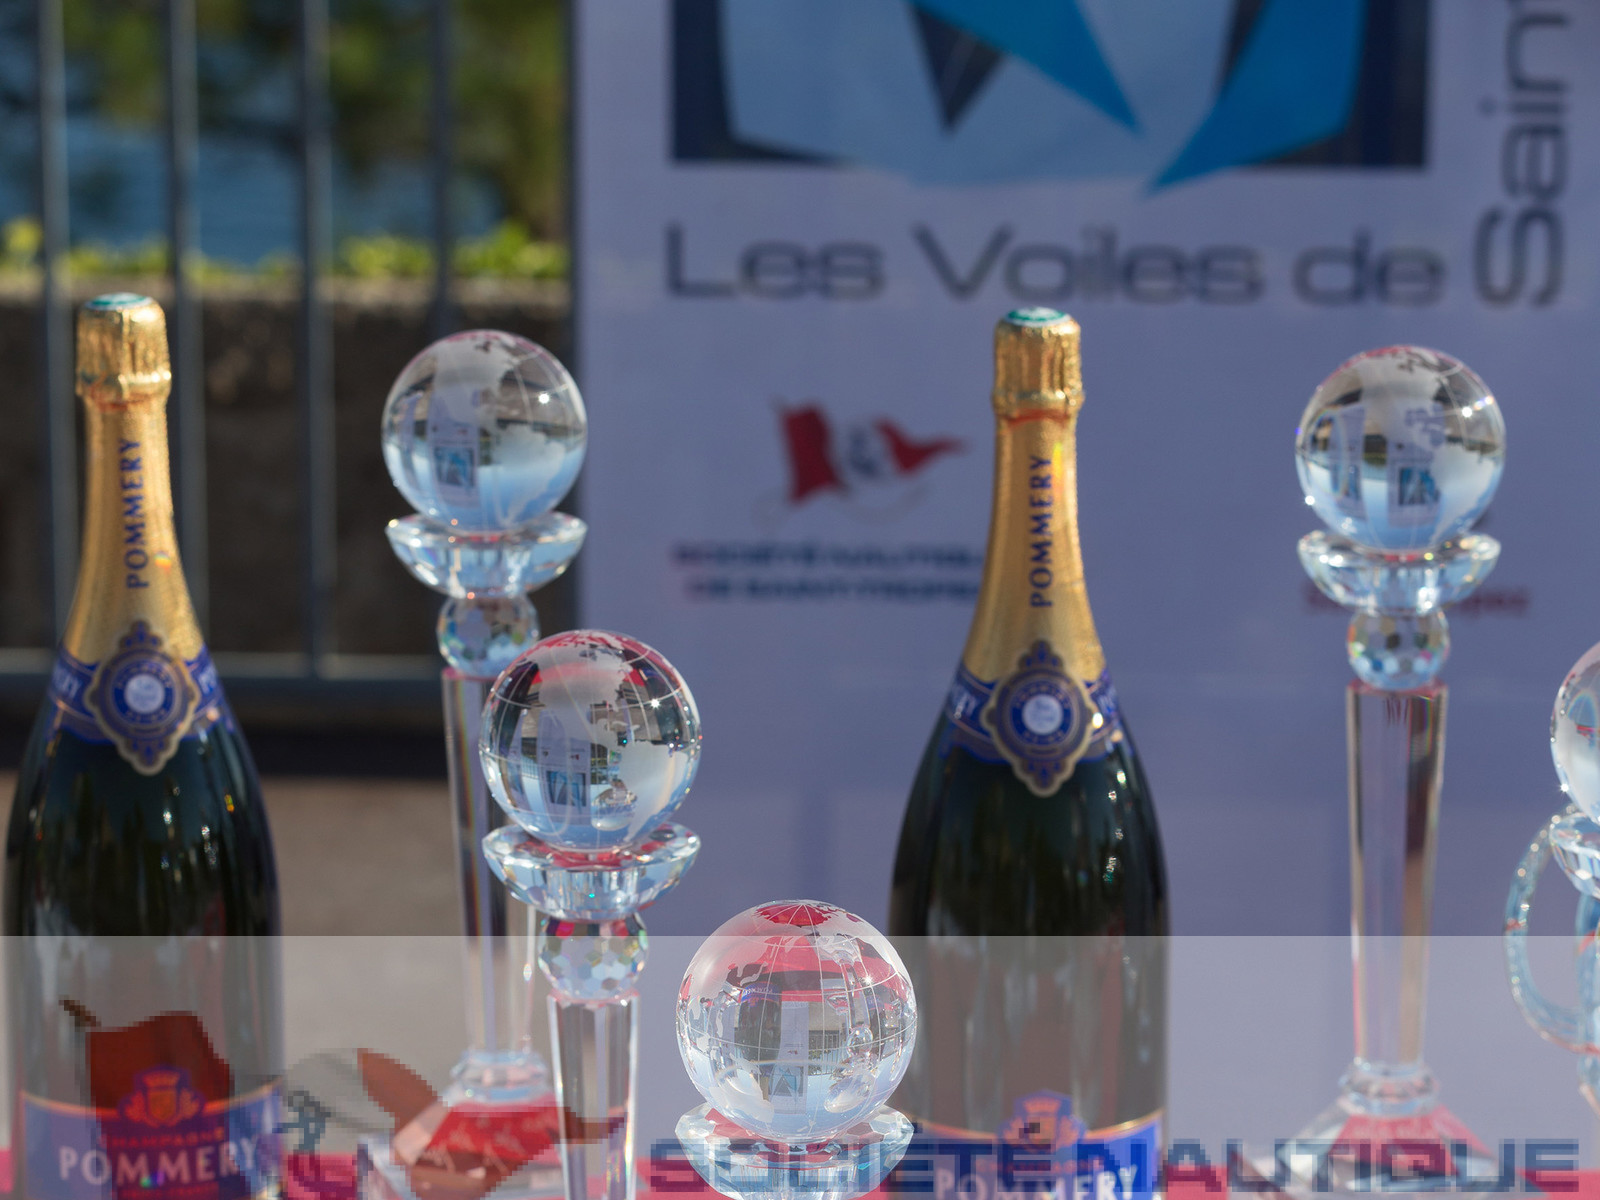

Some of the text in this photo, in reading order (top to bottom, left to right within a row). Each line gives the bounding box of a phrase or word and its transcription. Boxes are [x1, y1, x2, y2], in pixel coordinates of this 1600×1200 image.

[664, 222, 1446, 305] Les Voiles de
[118, 438, 150, 591] POMMERY
[1029, 455, 1054, 608] POMMERY
[58, 1138, 259, 1186] POMMERY
